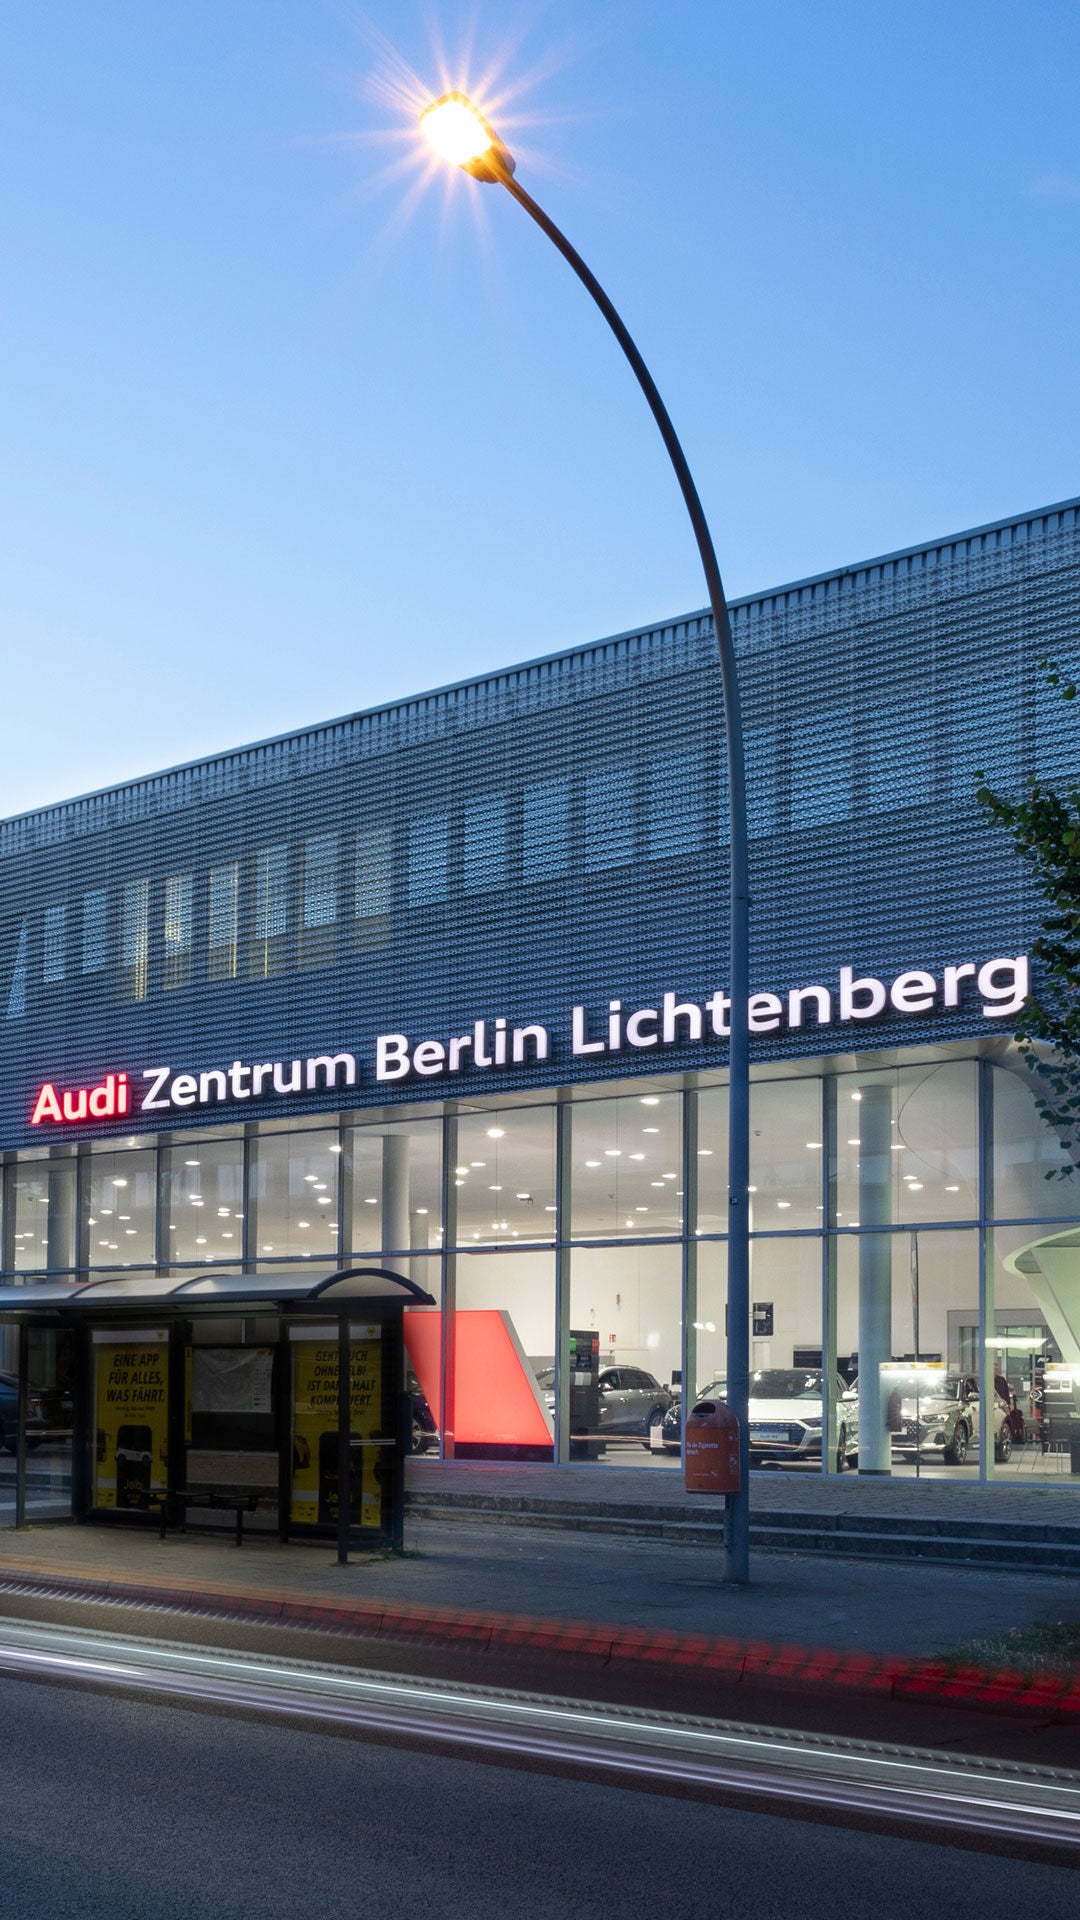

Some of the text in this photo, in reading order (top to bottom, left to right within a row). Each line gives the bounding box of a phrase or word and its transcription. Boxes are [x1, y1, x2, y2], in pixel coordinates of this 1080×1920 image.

[31, 956, 1030, 1124] Audi Zentrum Berlin Lichtenberg
[114, 1354, 159, 1366] EINE APP
[109, 1369, 163, 1385] FÜR ALLES,
[307, 1380, 322, 1391] IST
[352, 1380, 376, 1391] HALT
[107, 1387, 164, 1402] WAS FÄHRT.
